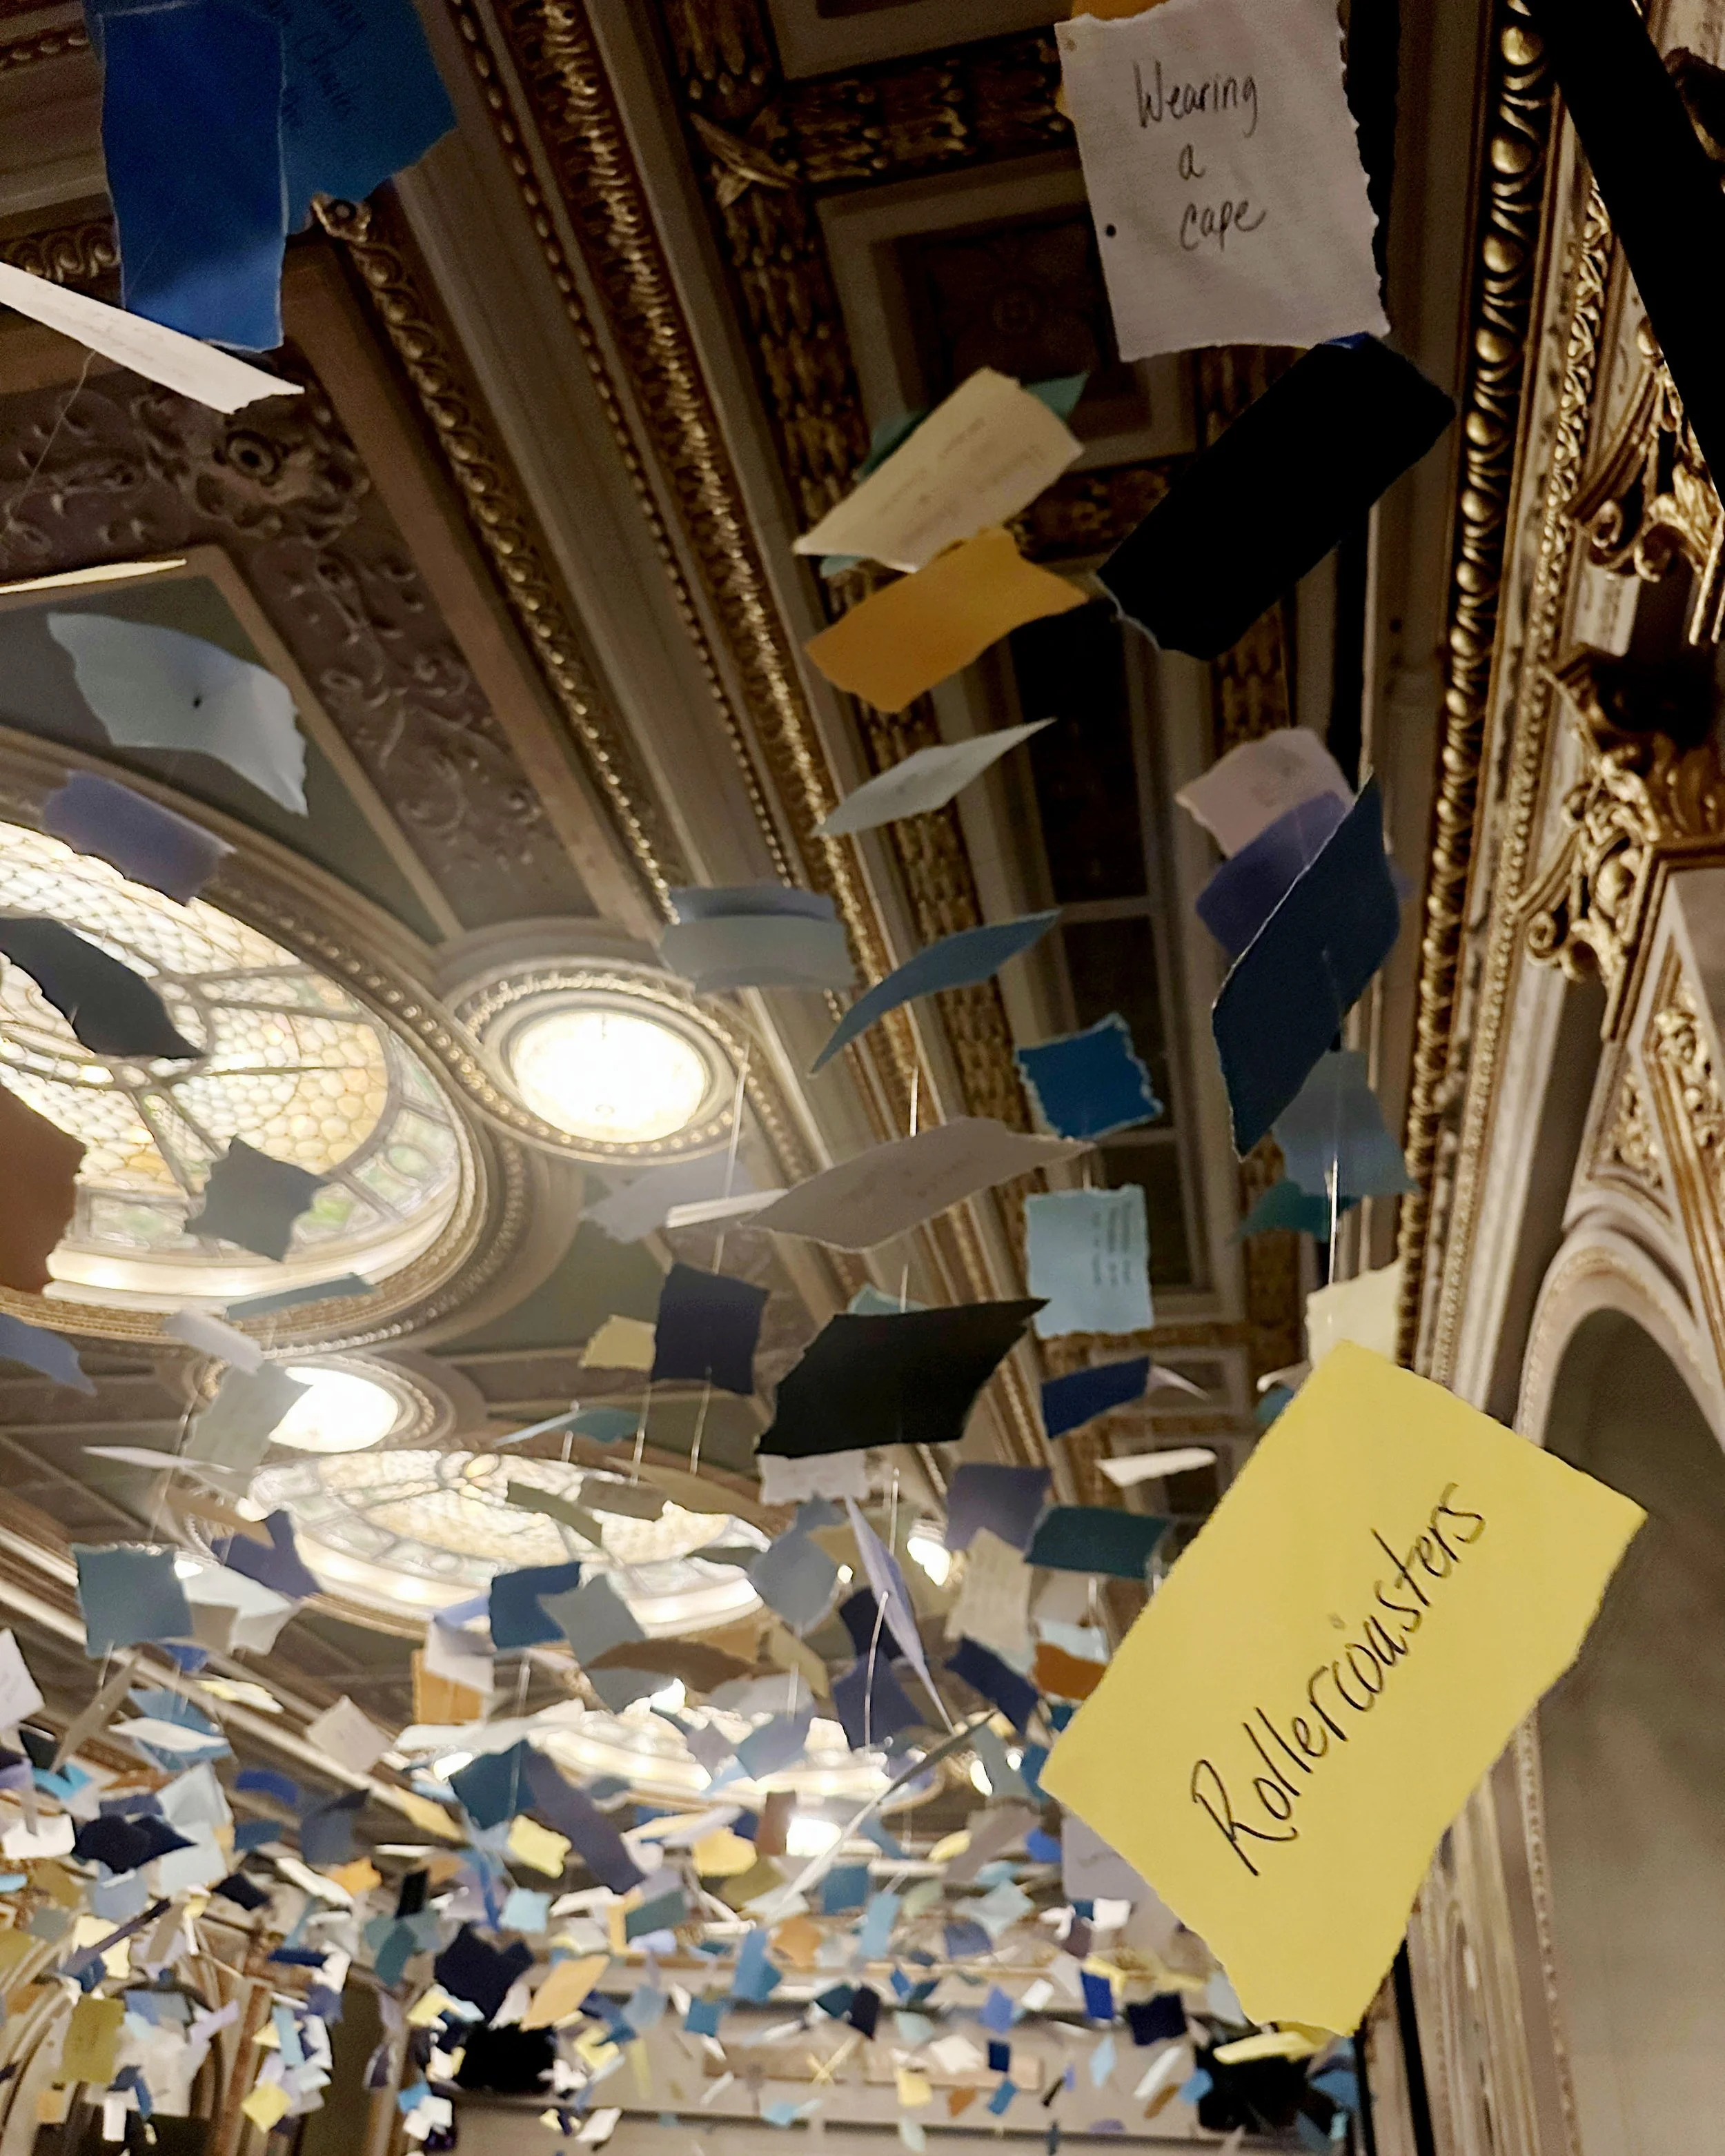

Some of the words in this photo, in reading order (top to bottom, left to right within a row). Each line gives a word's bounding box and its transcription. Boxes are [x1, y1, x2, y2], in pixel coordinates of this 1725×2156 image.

[1132, 59, 1259, 139] Wearing
[1177, 142, 1206, 181] a
[1191, 1482, 1486, 1877] Rollercoasters
